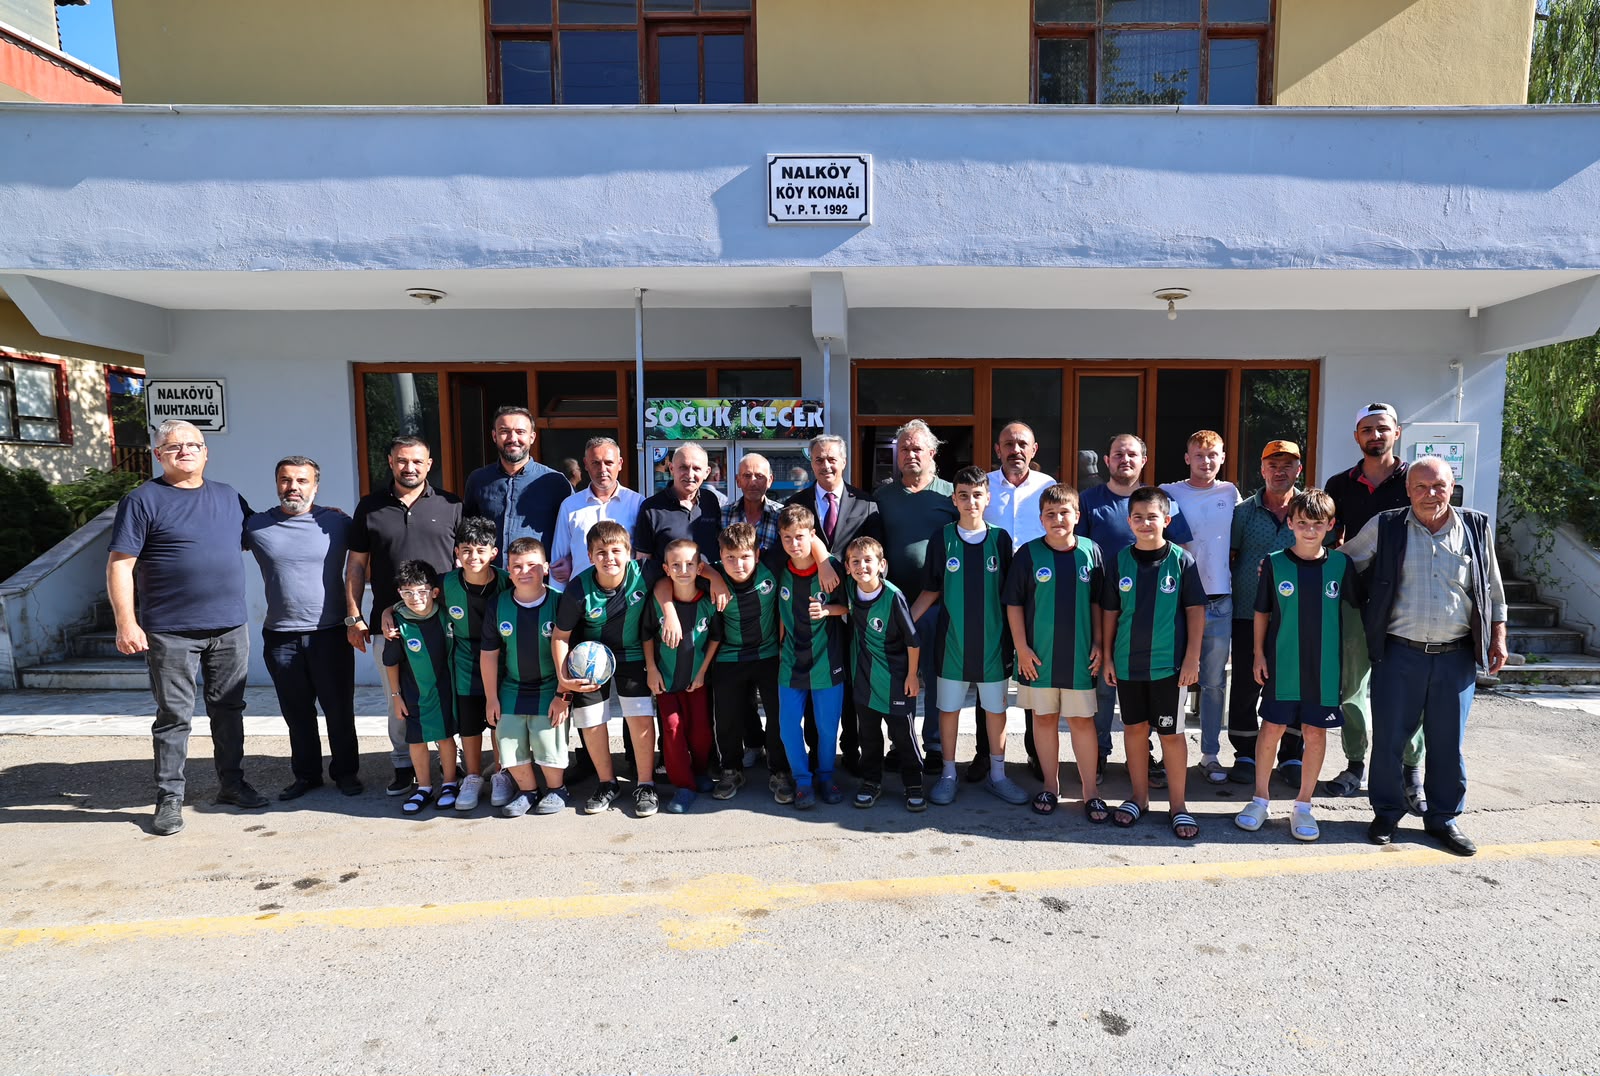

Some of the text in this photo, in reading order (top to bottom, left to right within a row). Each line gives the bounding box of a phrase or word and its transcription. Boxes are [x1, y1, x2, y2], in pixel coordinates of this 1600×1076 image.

[782, 163, 851, 179] NALKÖY
[776, 183, 860, 199] KÖY KONAĞI
[785, 204, 848, 215] Y. P. T. 1992
[158, 385, 214, 400] NALKÖYÜ
[154, 401, 219, 416] MUHTARLIĞI
[645, 400, 824, 433] SOĞUK İÇECEK
